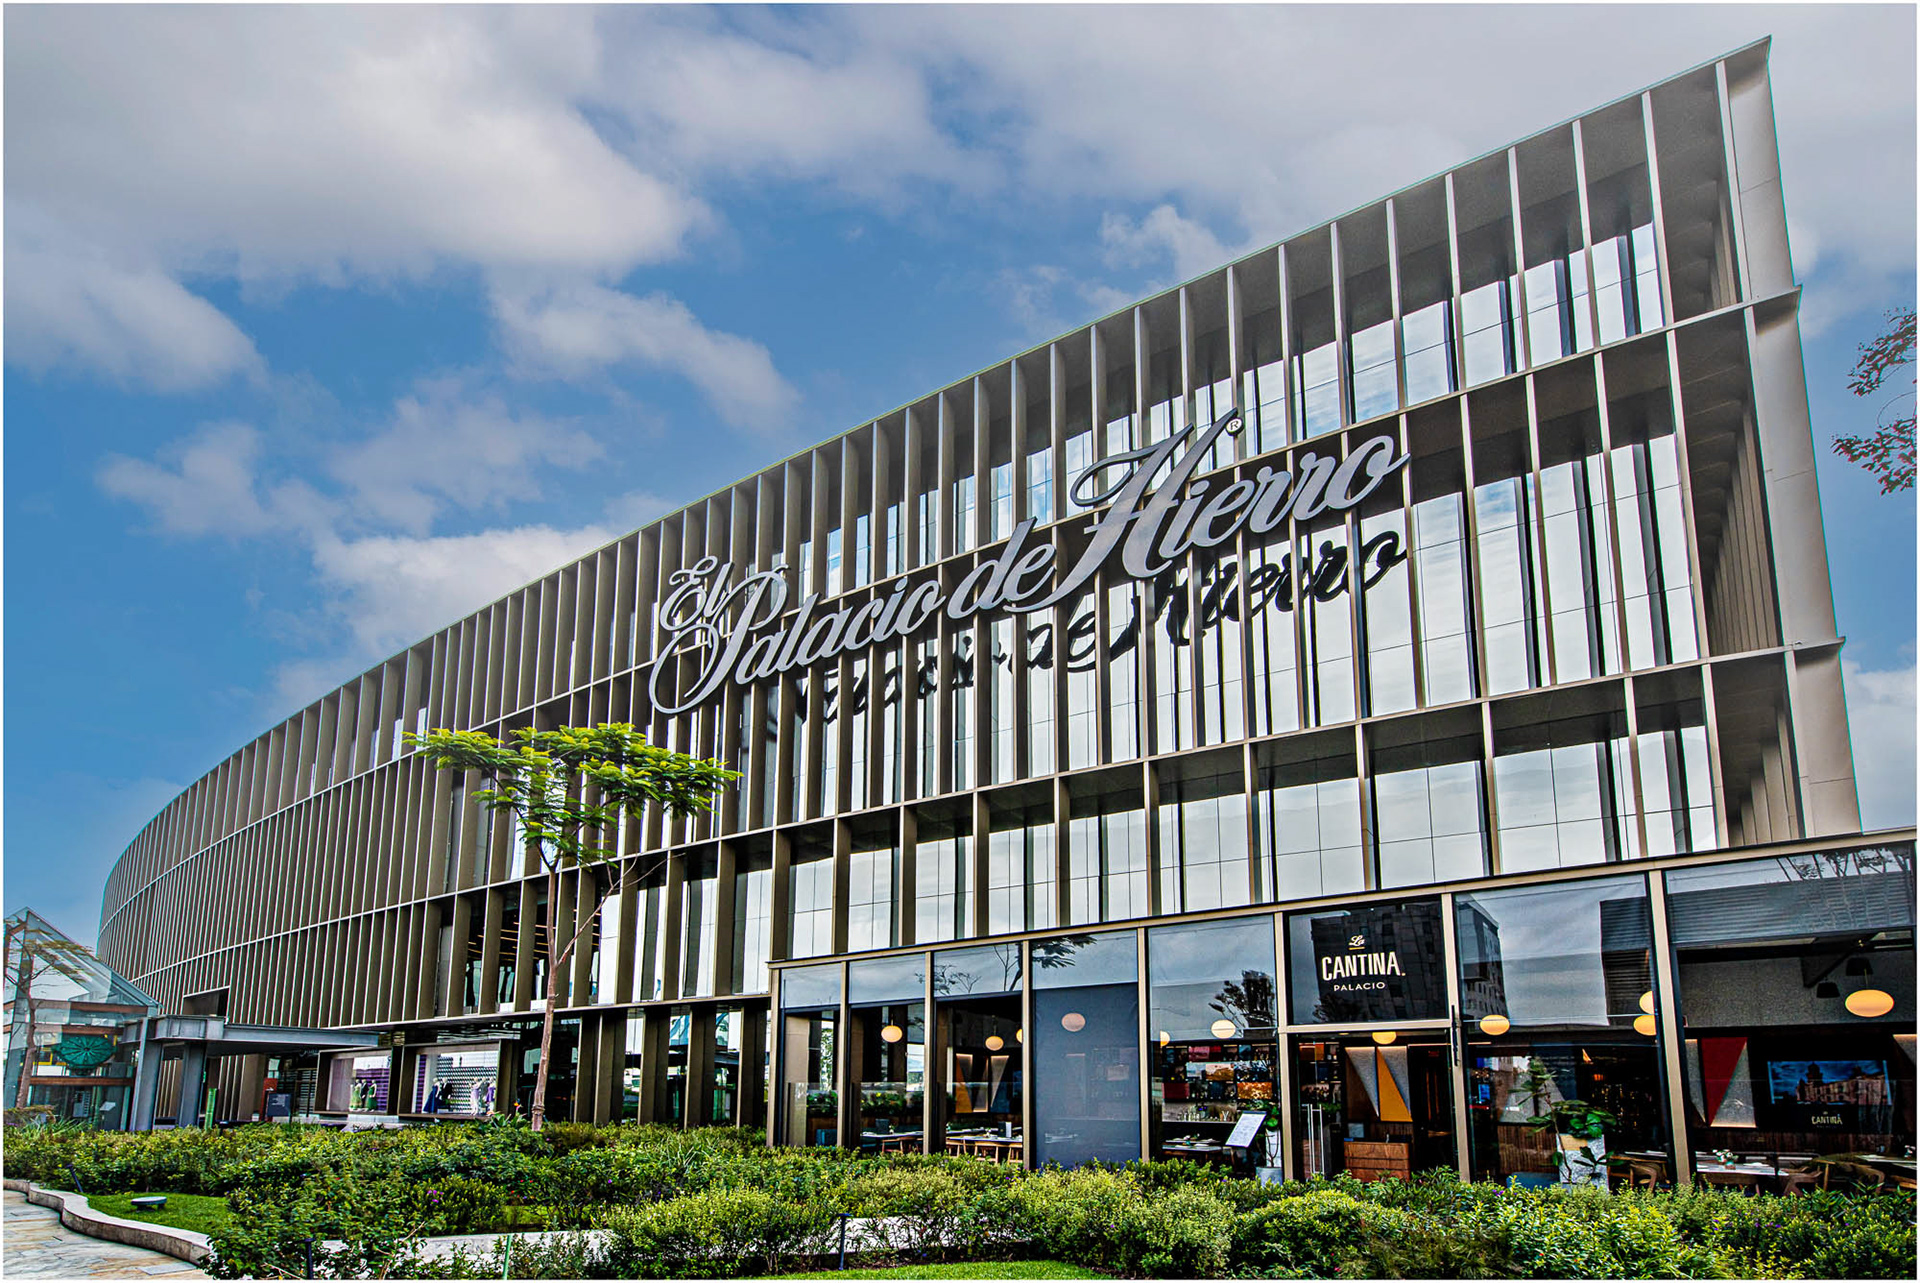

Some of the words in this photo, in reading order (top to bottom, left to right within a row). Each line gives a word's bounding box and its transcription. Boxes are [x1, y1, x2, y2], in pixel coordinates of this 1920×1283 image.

[1003, 407, 1411, 613] Hierro
[659, 555, 734, 631] El
[947, 516, 1056, 619] de
[648, 564, 946, 714] Palacio
[1348, 934, 1366, 947] La
[1333, 981, 1386, 992] PALACIO
